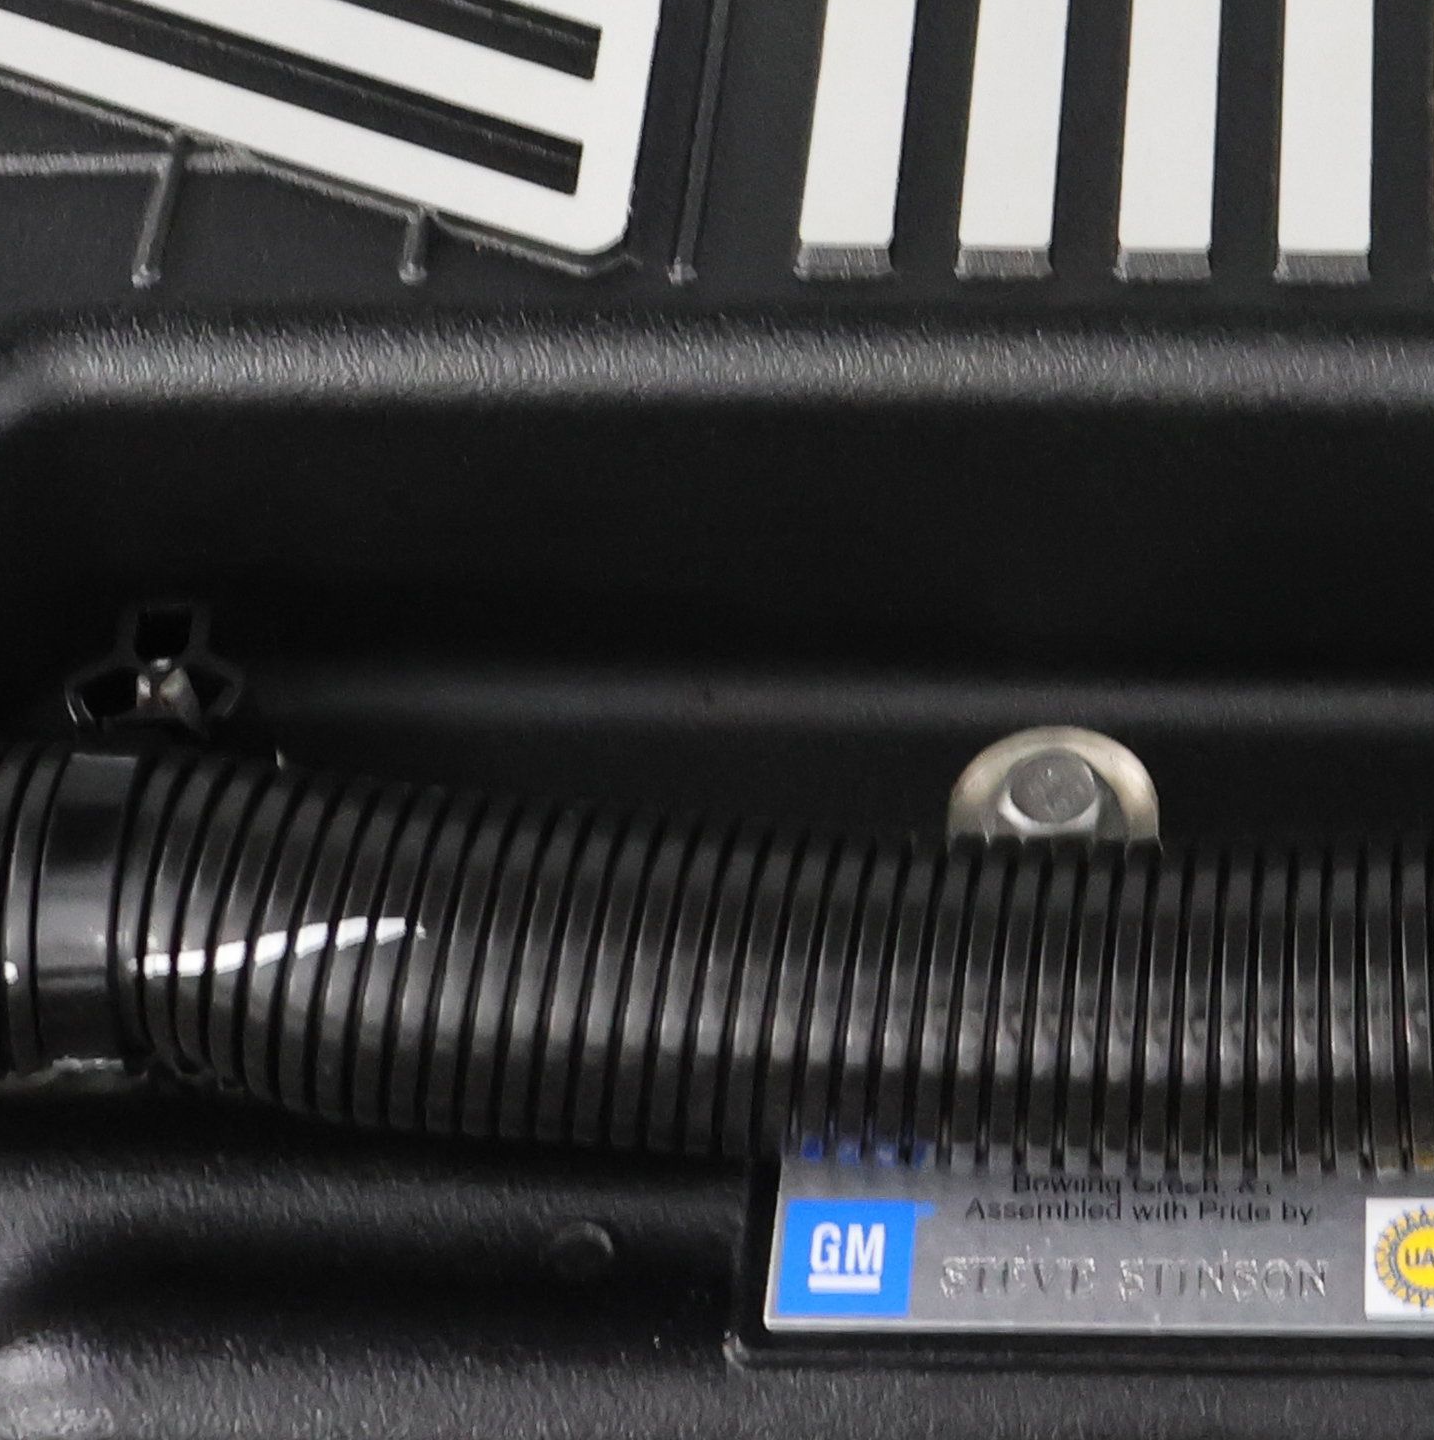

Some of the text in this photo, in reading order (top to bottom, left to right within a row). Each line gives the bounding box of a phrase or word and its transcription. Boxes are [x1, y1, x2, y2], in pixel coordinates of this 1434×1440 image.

[967, 1197, 1314, 1225] Assembled with Pride by
[810, 1221, 886, 1274] GM
[940, 1255, 1330, 1302] STEVE STINSON
